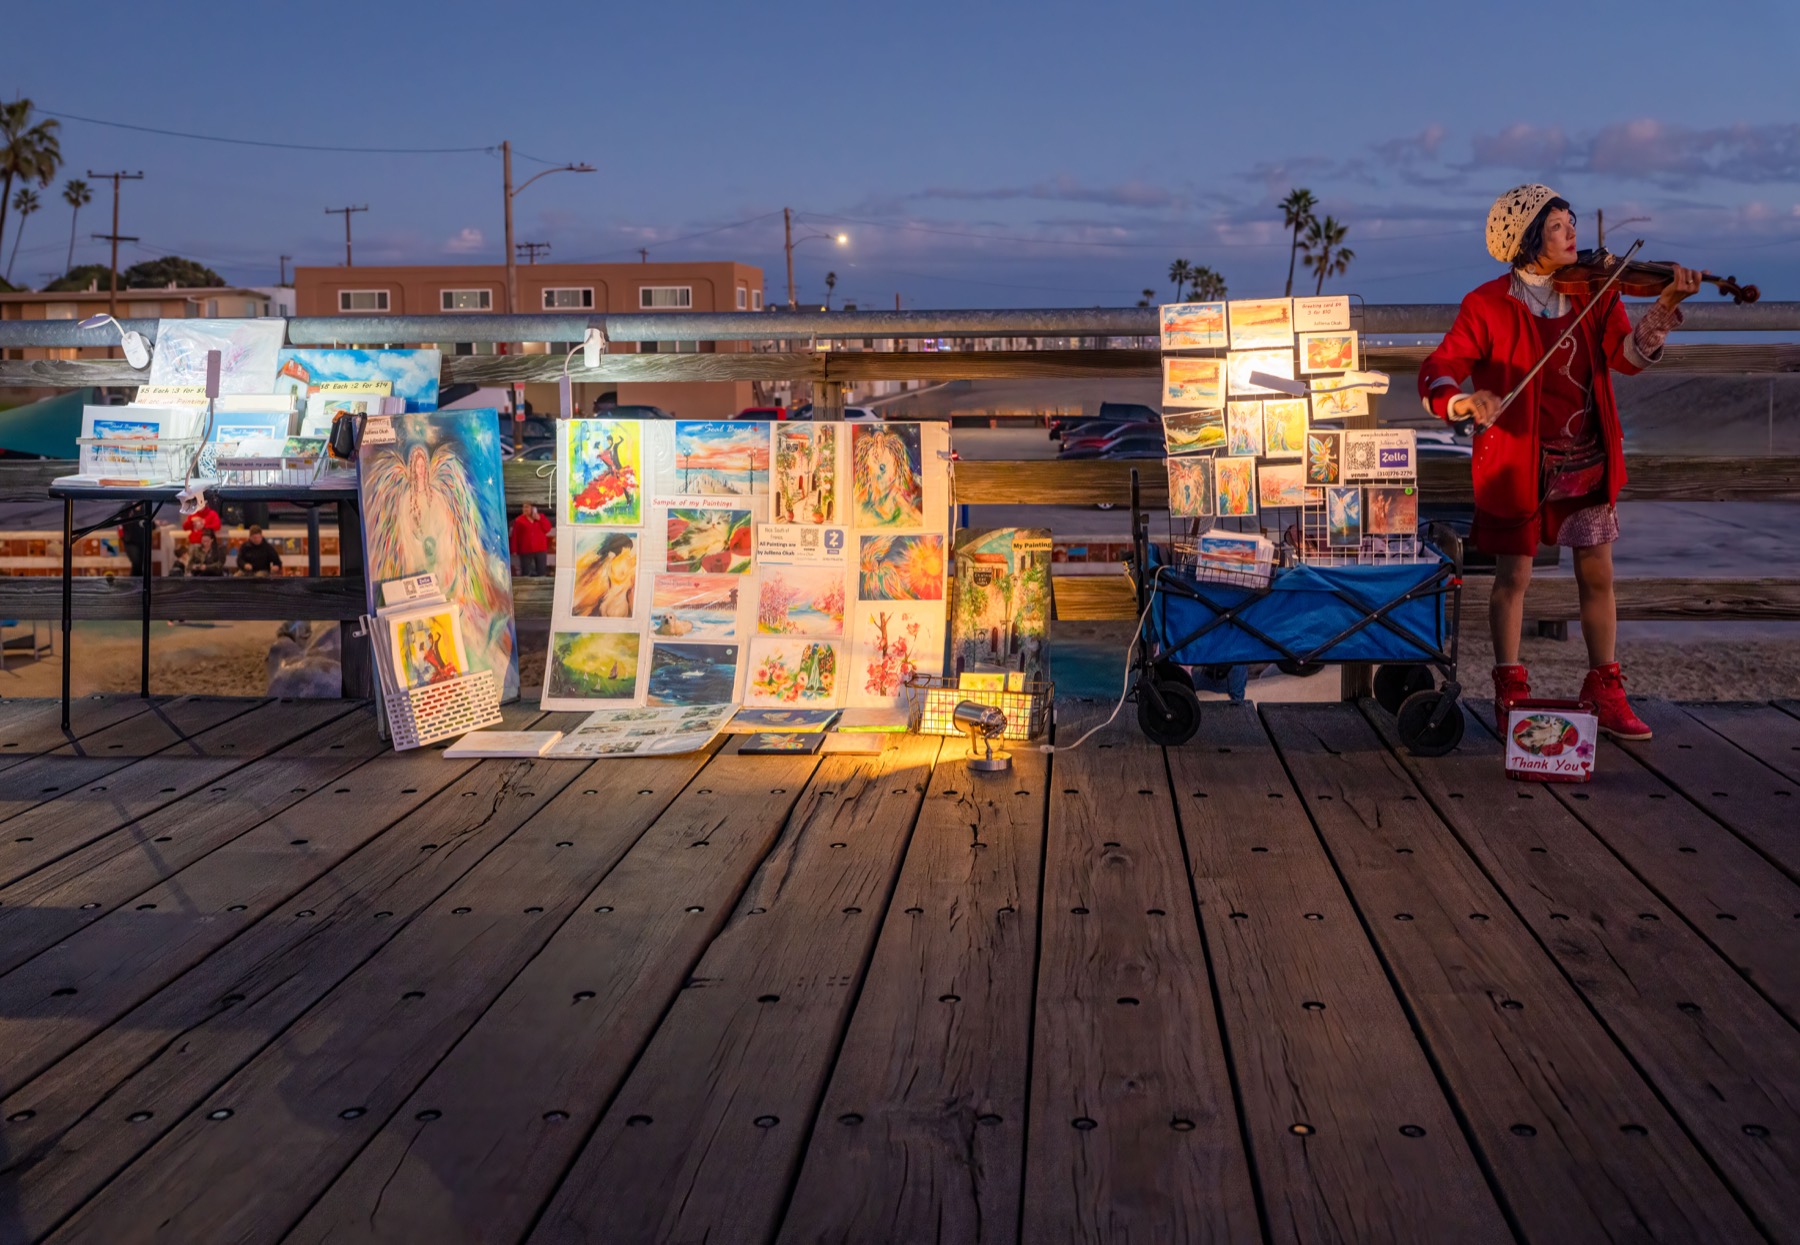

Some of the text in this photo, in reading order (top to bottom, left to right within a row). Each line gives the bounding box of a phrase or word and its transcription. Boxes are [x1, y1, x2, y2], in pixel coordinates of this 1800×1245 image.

[704, 423, 753, 433] Seal Beach
[1382, 452, 1407, 463] Zelle
[653, 498, 676, 507] Sample
[702, 499, 733, 508] Paintings
[1511, 756, 1579, 771] Thank You
